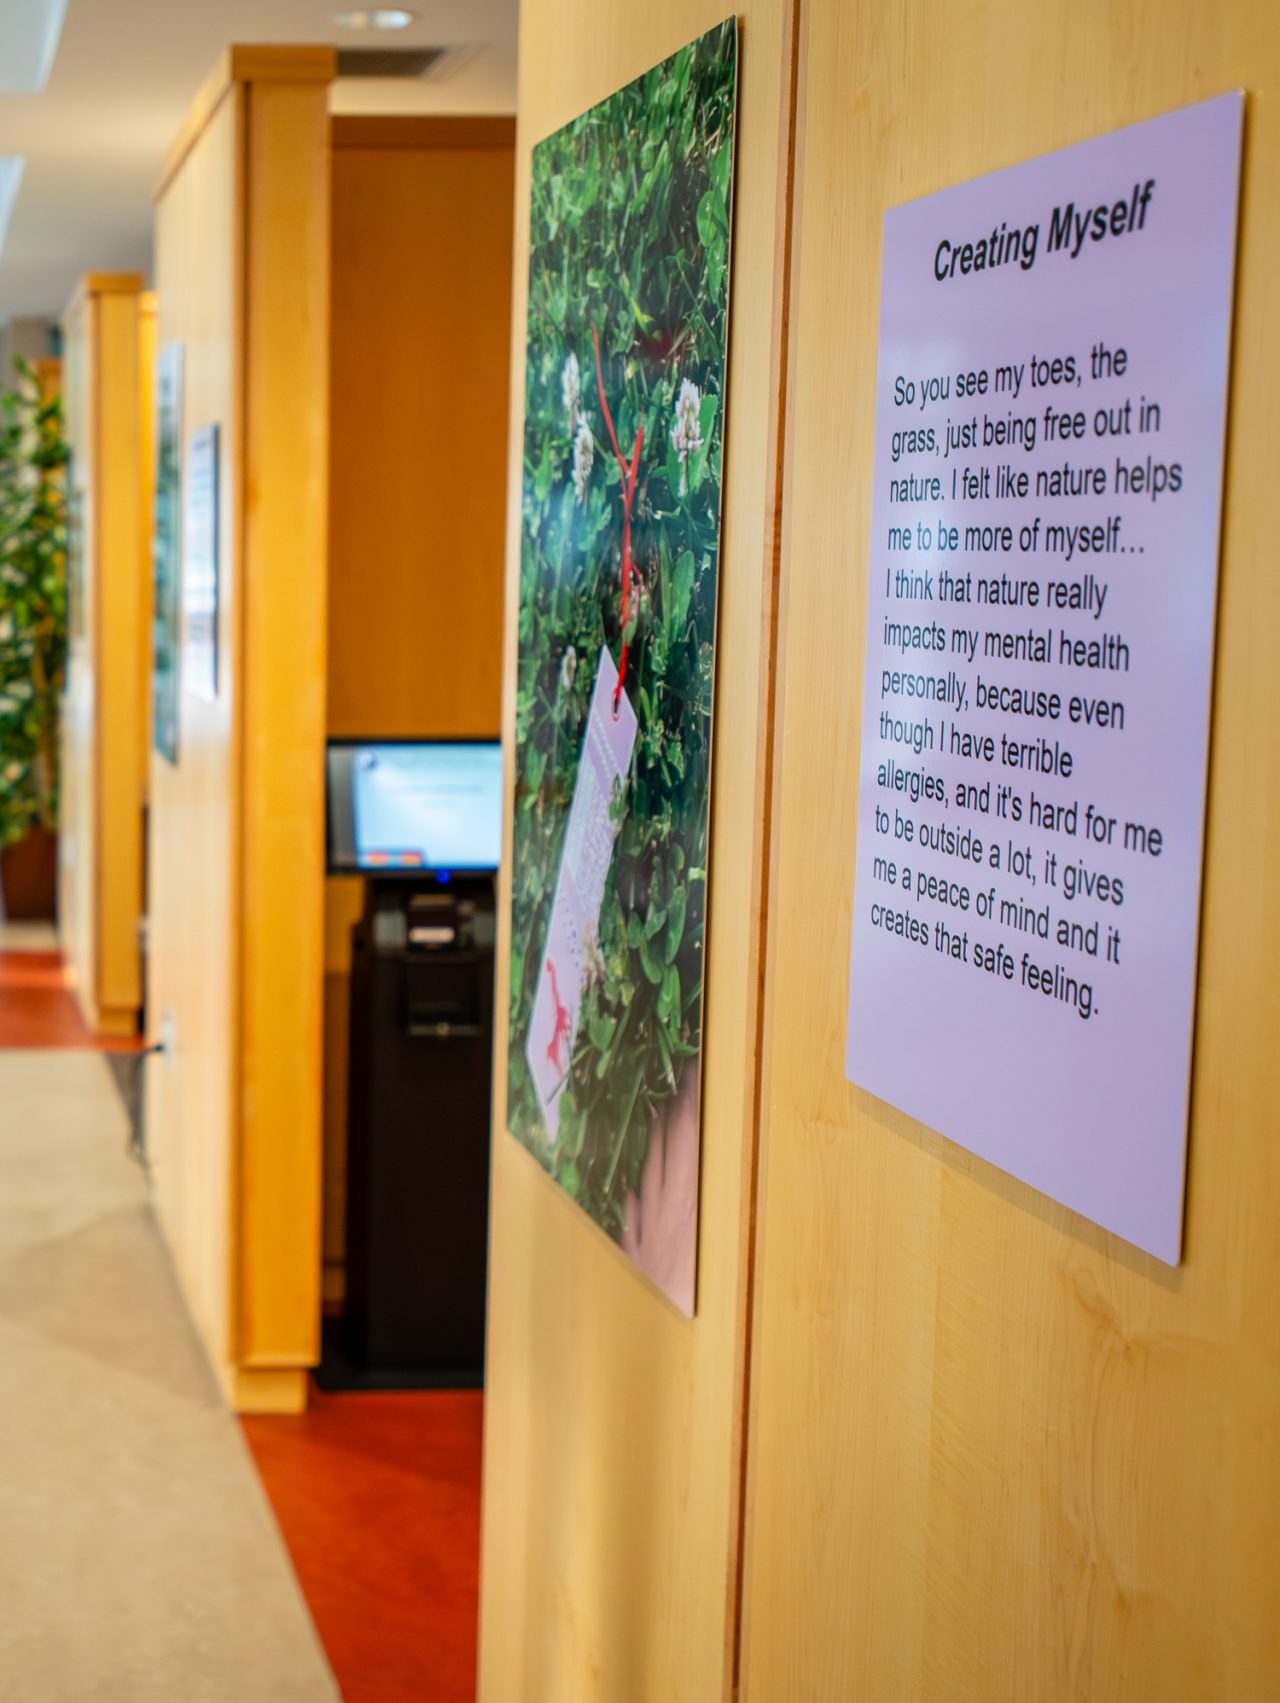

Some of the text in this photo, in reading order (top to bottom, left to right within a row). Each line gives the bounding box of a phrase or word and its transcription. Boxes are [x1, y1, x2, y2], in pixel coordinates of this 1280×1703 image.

[933, 178, 1156, 282] Creating Myself
[893, 342, 1128, 412] So you see my toes, the
[891, 395, 1161, 463] grass, just being free out in
[889, 455, 1183, 503] nature. I felt like nature helps
[887, 527, 912, 551] me
[916, 522, 932, 551] to
[937, 519, 959, 552] be
[964, 526, 1013, 552] more
[1019, 517, 1041, 553] of
[886, 567, 1108, 620] I think that nature really
[883, 615, 1130, 672] impacts my mental health
[881, 670, 1125, 730] personally, because even
[879, 710, 1074, 779] though I have terrible
[877, 759, 1163, 857] allergies, and it's hard for me
[875, 804, 1124, 906] to be outside a lot, it gives
[873, 857, 1121, 965] me a peace of mind and it
[871, 903, 1099, 1020] creates that safe feeling.
